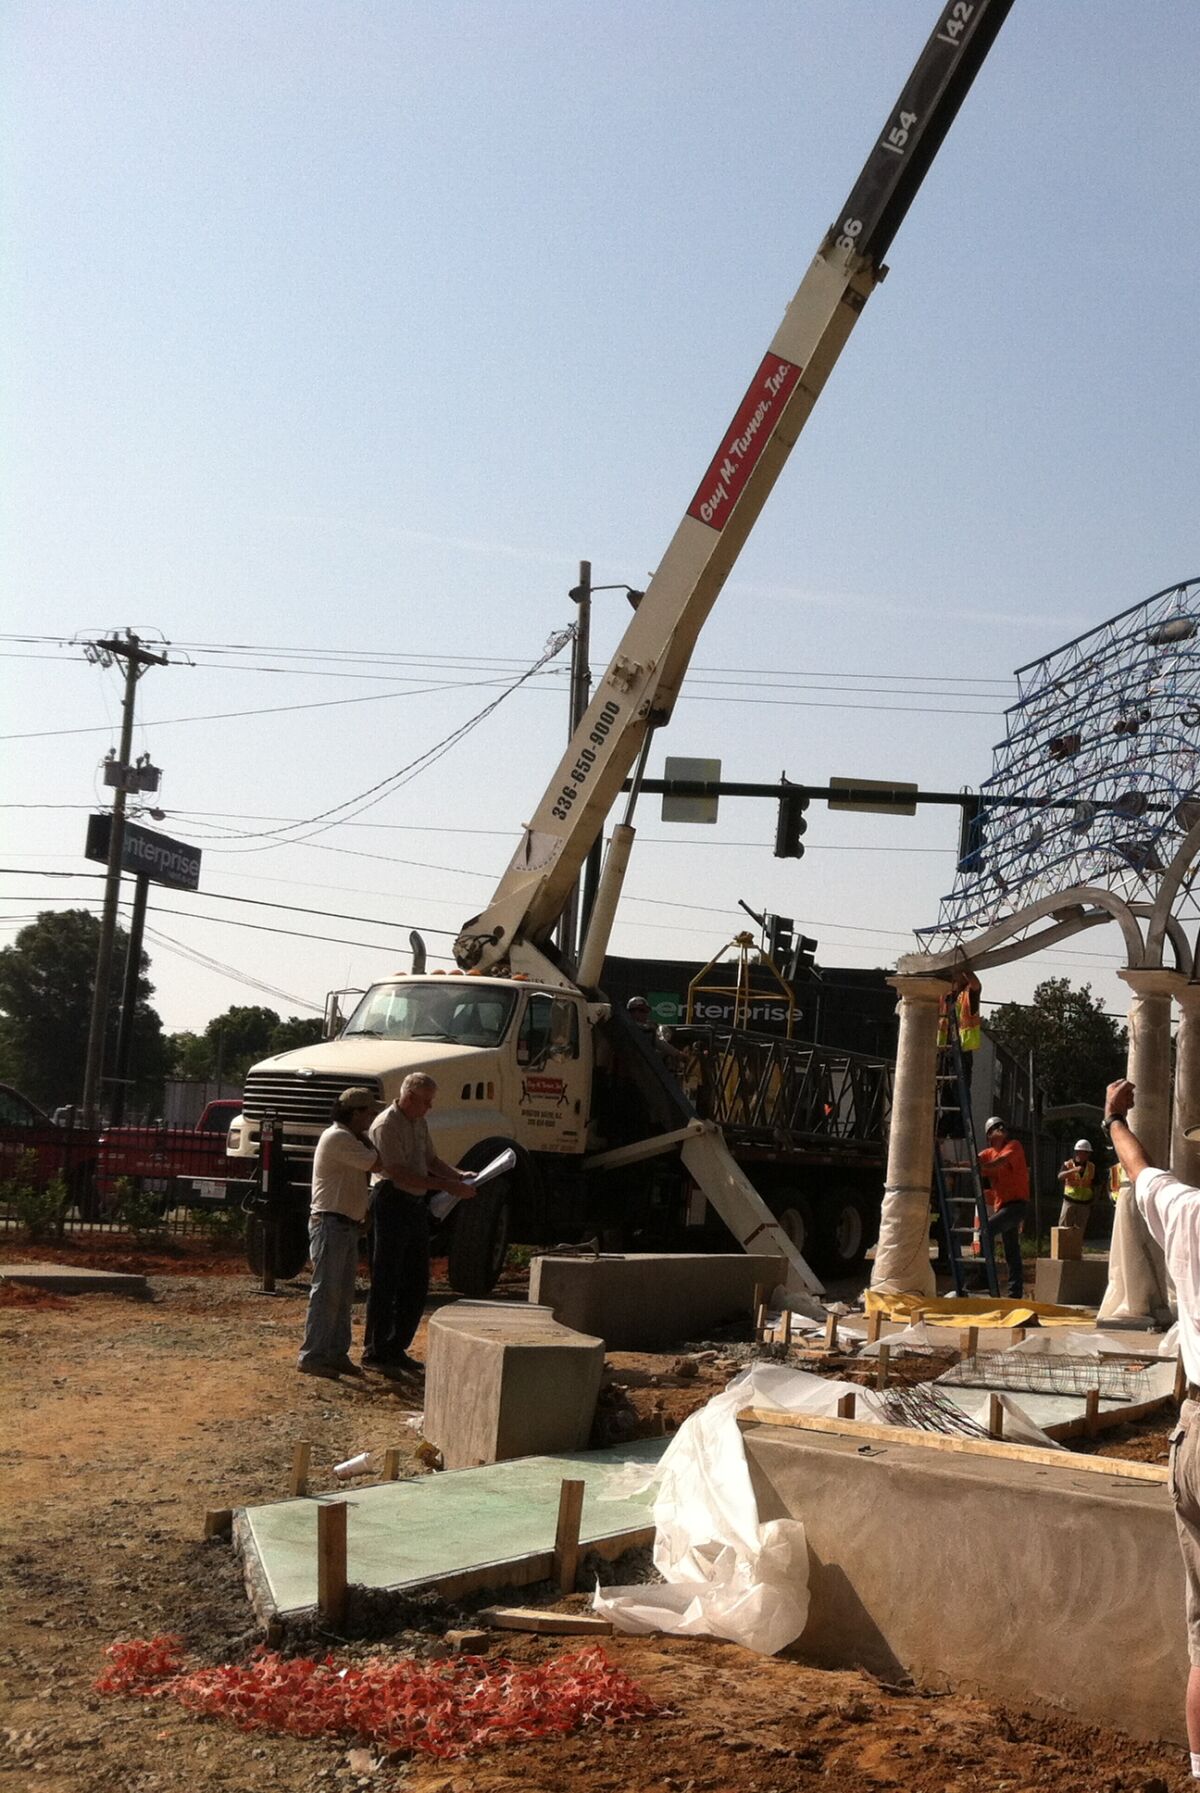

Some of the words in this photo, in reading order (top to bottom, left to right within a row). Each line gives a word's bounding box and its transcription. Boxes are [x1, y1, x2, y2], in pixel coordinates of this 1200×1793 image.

[764, 363, 792, 397] Inc.
[729, 400, 773, 459] Turner,
[719, 458, 740, 485] M.
[701, 482, 729, 522] Guy
[552, 701, 620, 820] 336-650-9000
[124, 834, 200, 877] nterprise
